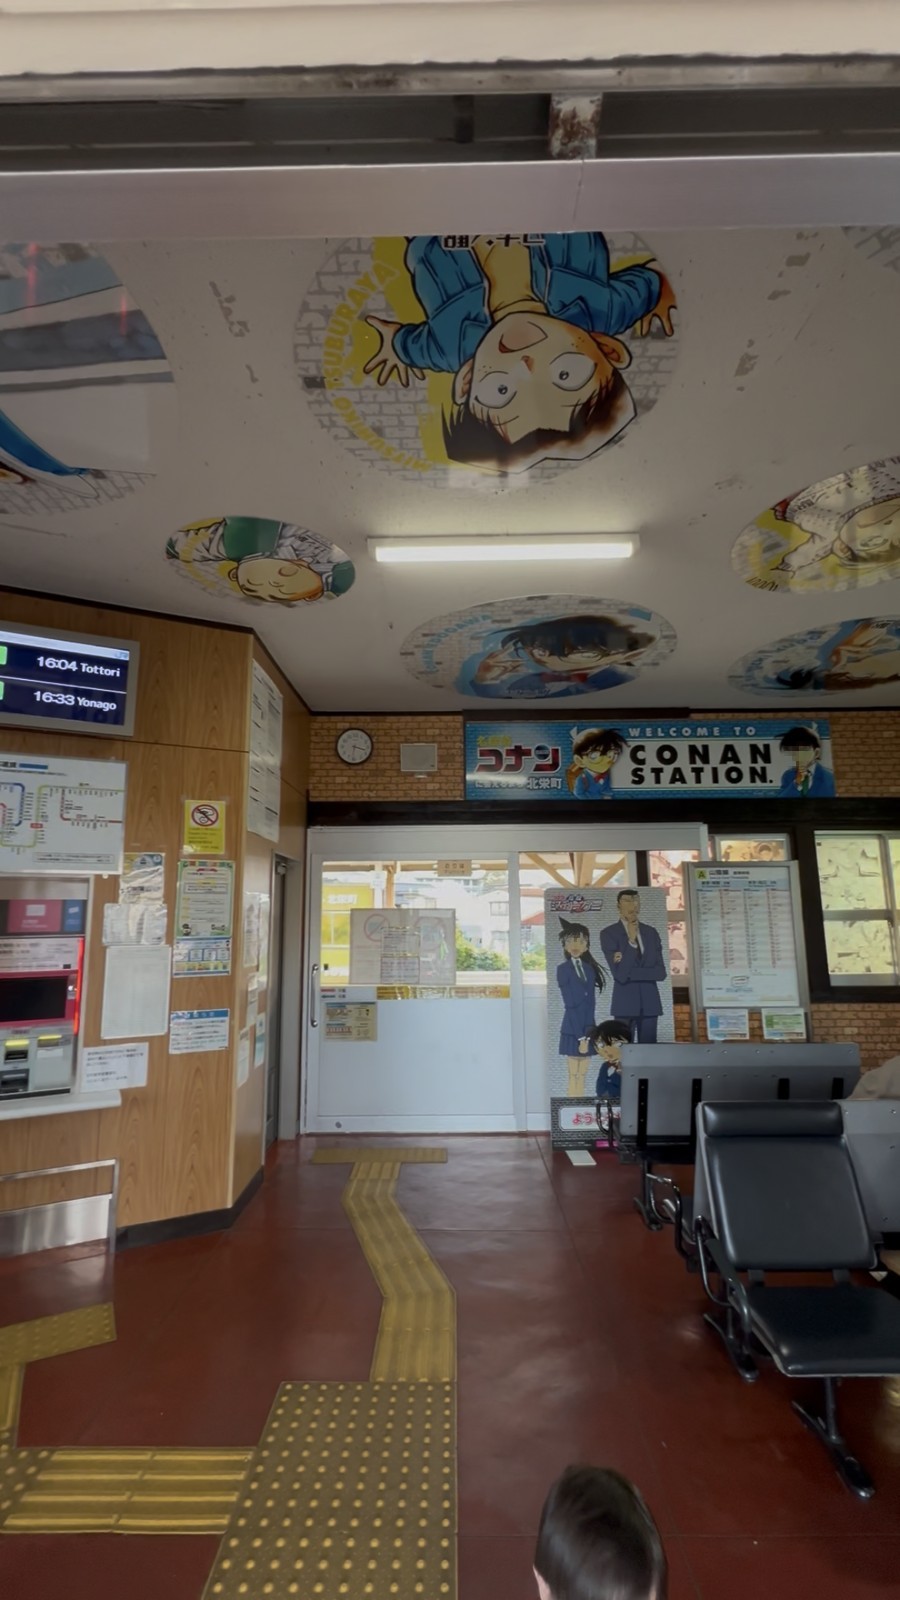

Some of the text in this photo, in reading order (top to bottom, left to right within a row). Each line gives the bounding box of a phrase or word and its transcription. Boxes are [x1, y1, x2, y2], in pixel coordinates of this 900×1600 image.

[323, 262, 433, 473] MITSUHIKO TSUBURAYA
[37, 656, 121, 678] 16:04 Tottori
[33, 690, 117, 712] 16:33 Yonago
[628, 726, 757, 737] WELCOME TO
[474, 743, 562, 774] コナン
[629, 743, 772, 766] CONAN
[526, 776, 562, 790] 北栄町
[630, 766, 774, 785] STATION.
